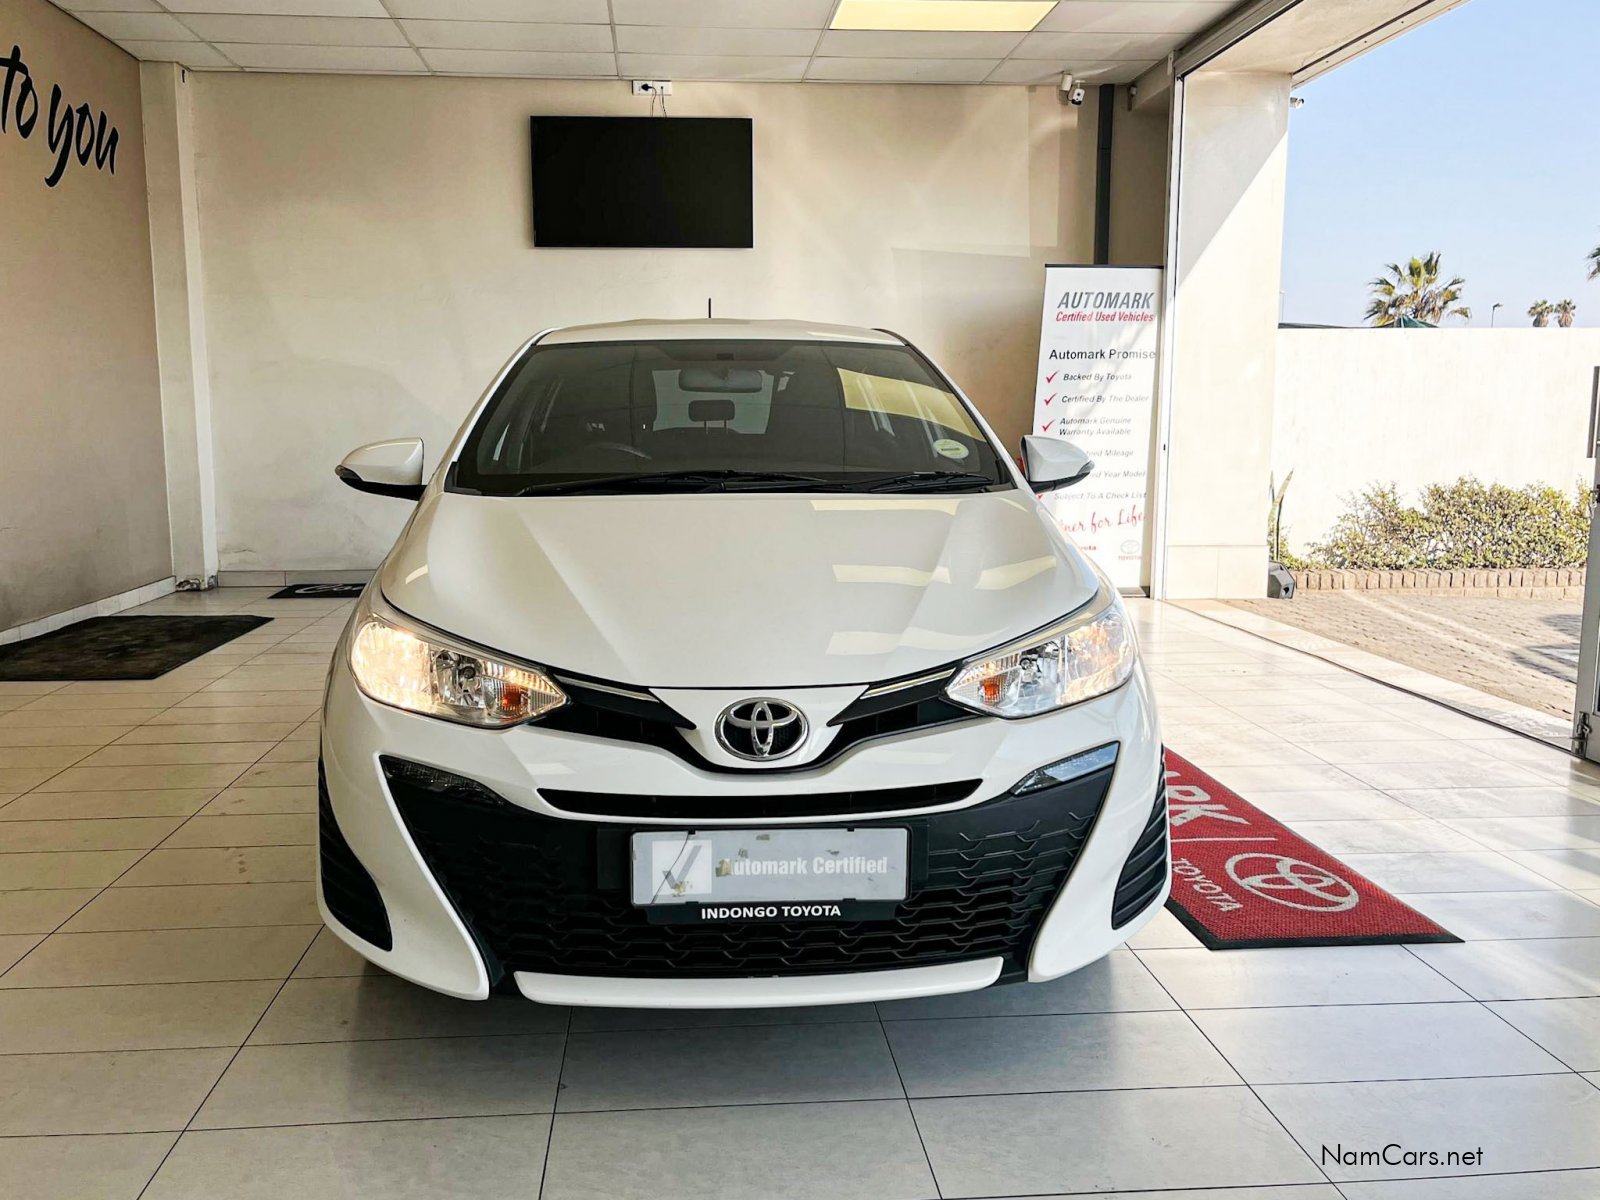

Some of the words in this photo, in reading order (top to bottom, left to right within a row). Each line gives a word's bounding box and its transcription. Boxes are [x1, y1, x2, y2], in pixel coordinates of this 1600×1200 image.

[0, 45, 38, 139] to
[44, 84, 119, 187] you
[1057, 291, 1155, 309] AUTOMARK
[1056, 311, 1093, 322] Certified
[1095, 312, 1115, 322] Used
[1118, 311, 1155, 322] Vehicles
[1049, 349, 1106, 360] Automark
[1109, 348, 1156, 360] Promise
[1063, 373, 1092, 381] Backed
[1094, 373, 1104, 382] By
[1106, 373, 1132, 381] Toyota
[1061, 395, 1095, 404] Certified
[1096, 394, 1106, 404] By
[1060, 428, 1095, 437] Warranty
[813, 856, 888, 875] Certified
[701, 906, 778, 919] INDONGO
[783, 905, 841, 917] TOYOTA
